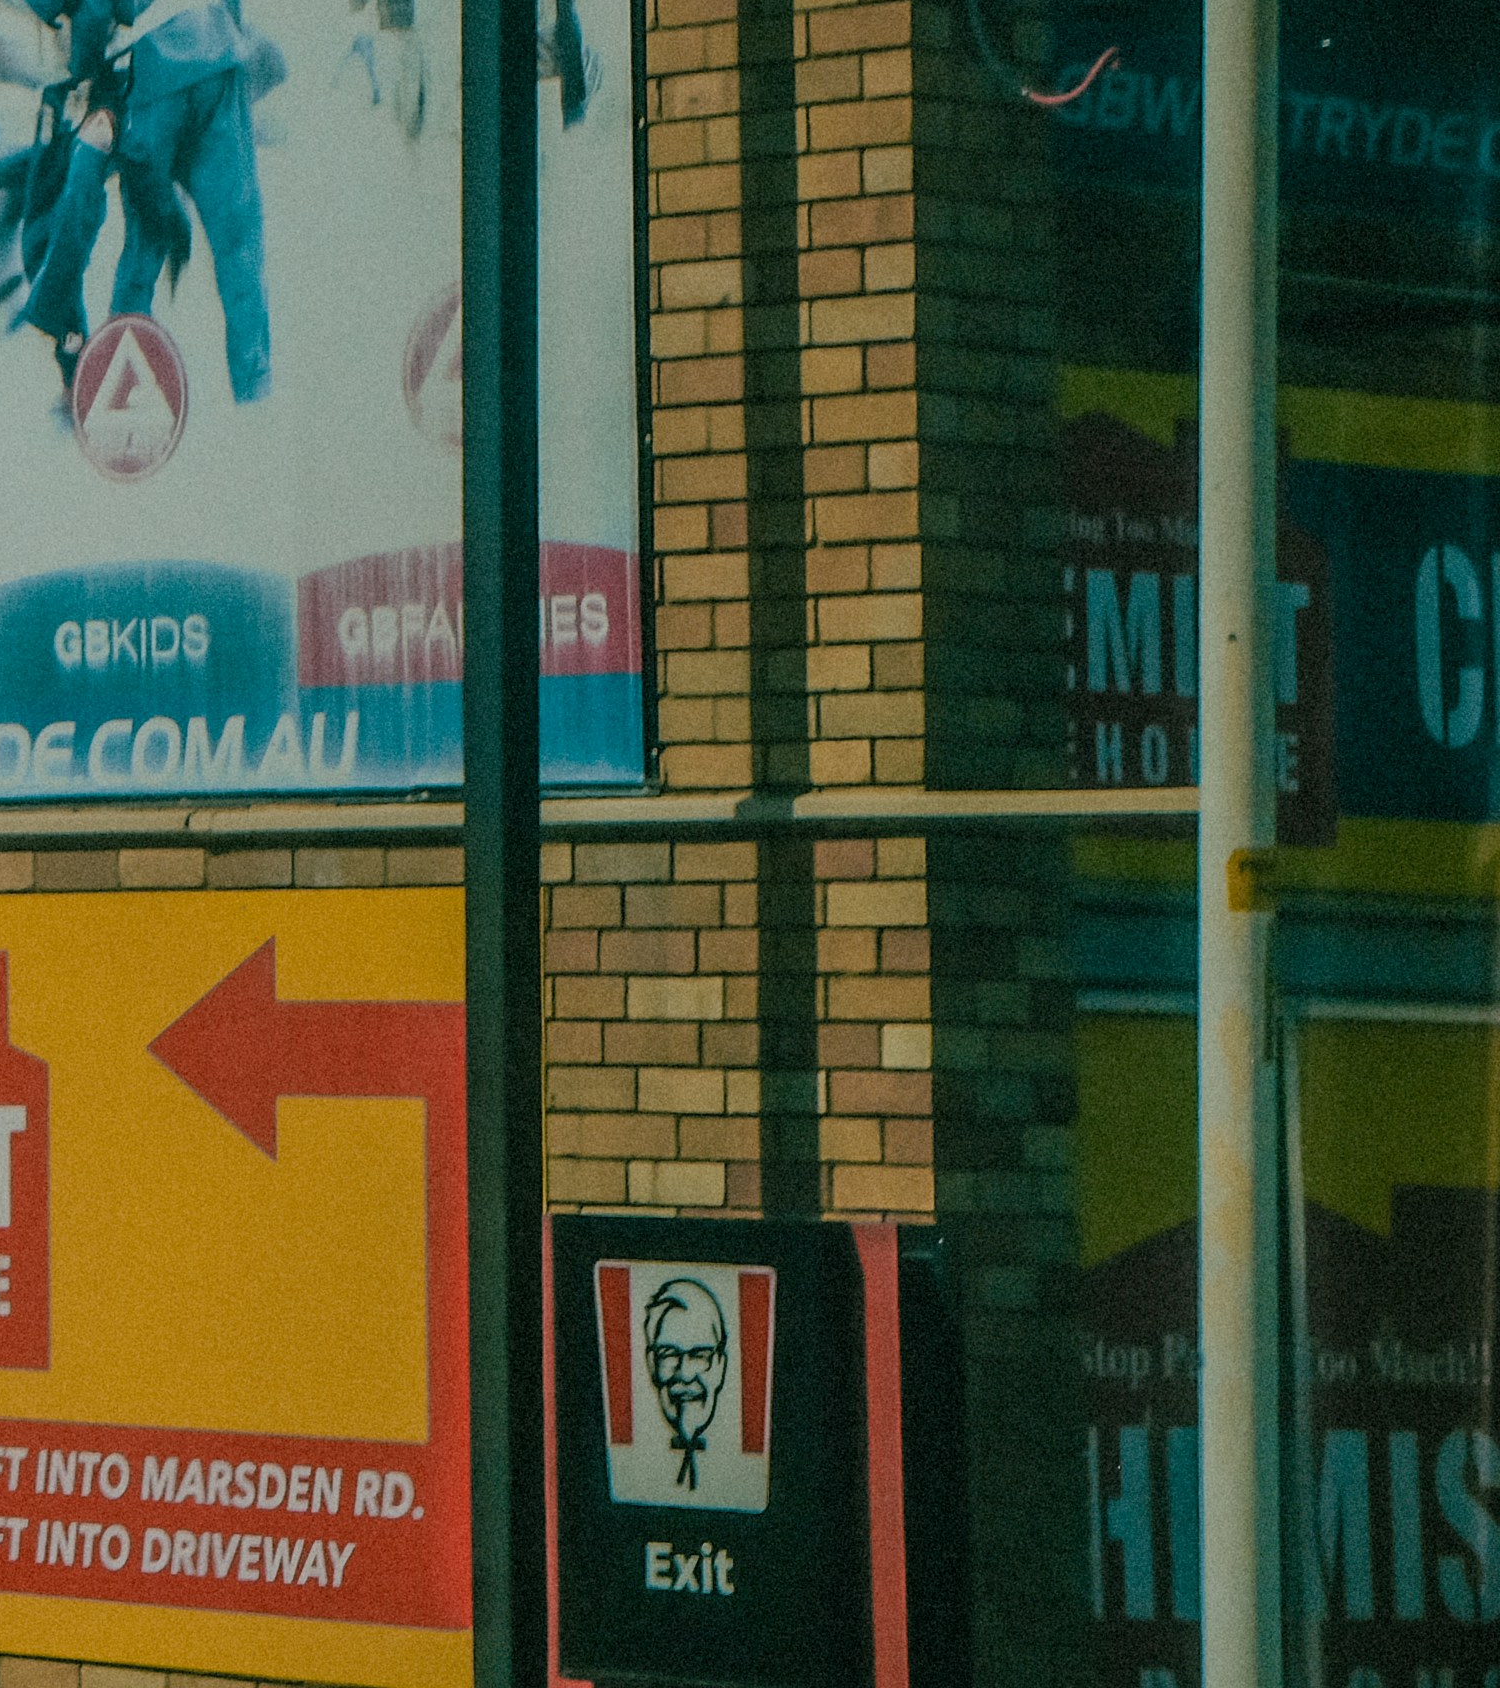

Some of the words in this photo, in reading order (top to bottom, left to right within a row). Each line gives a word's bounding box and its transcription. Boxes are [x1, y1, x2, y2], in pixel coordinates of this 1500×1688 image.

[54, 615, 211, 667] GBKIDS
[35, 1450, 130, 1500] INTO
[140, 1455, 336, 1515] MARSDEN
[353, 1469, 425, 1519] RD.
[35, 1519, 130, 1571] INTO
[141, 1527, 356, 1589] DRIVEWAY
[645, 1542, 735, 1596] Exit
